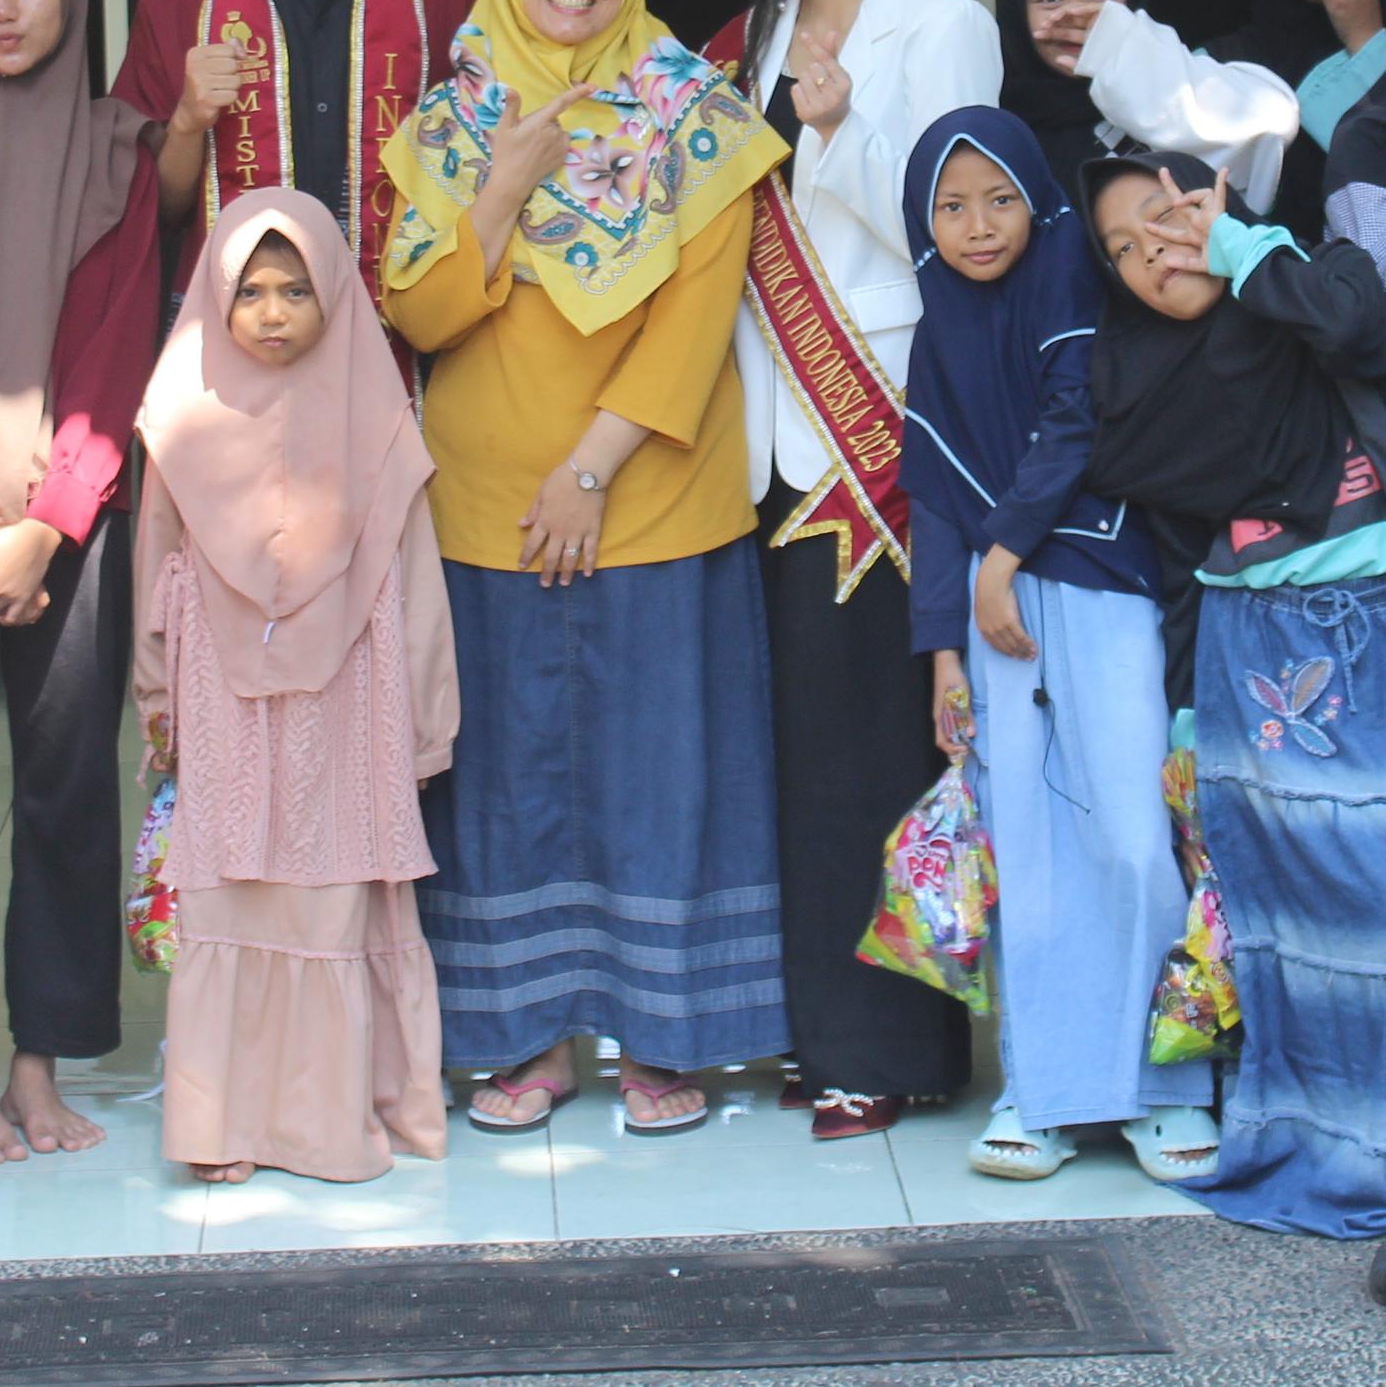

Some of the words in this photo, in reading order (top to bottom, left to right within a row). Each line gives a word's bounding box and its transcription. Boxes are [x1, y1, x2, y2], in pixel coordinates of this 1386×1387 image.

[228, 90, 262, 193] MIST
[787, 312, 874, 433] INDONESIA
[847, 420, 902, 472] 2023
